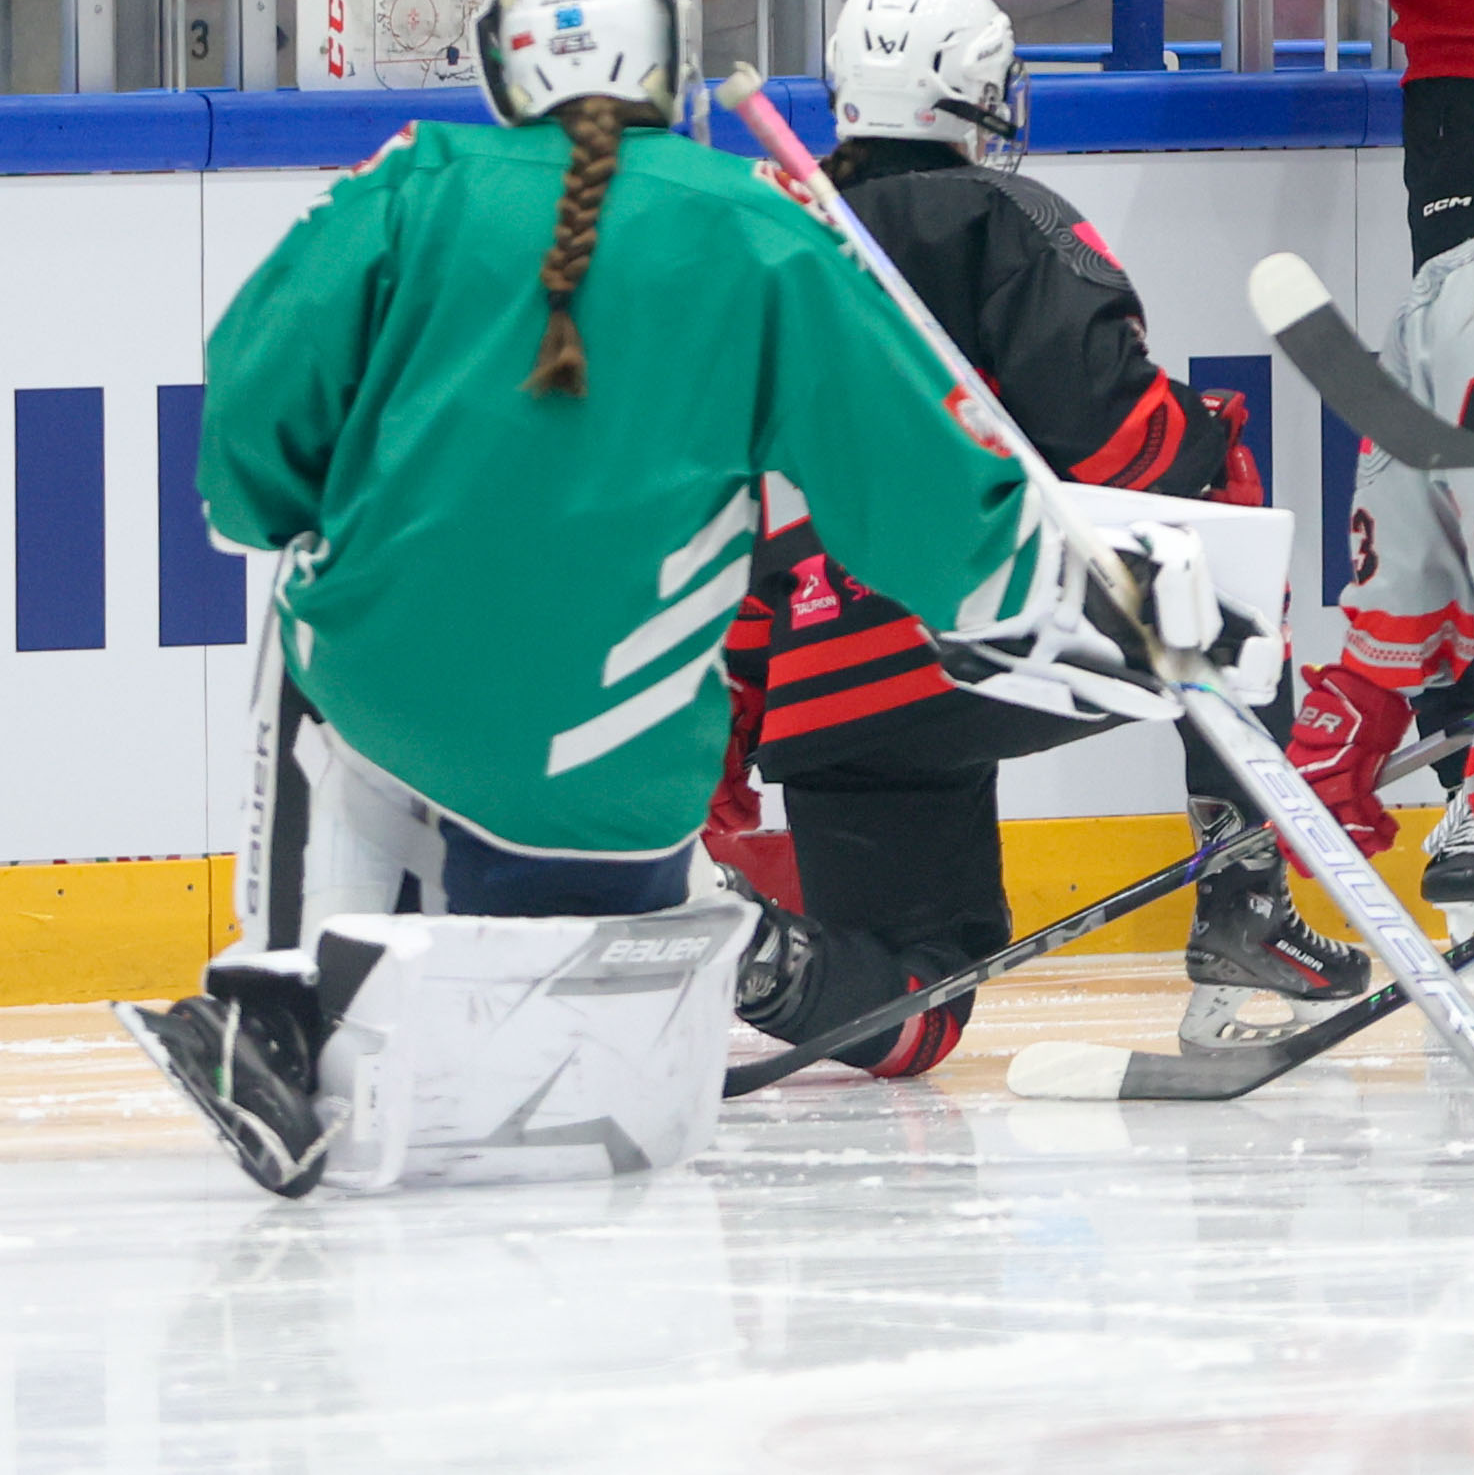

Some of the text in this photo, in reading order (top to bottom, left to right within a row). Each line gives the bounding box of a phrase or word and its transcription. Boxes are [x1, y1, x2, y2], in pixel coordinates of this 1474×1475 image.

[191, 19, 208, 60] 3
[1422, 194, 1472, 219] CCM
[1349, 508, 1377, 585] 3
[601, 935, 711, 964] BAUER
[1276, 938, 1325, 973] BAUER
